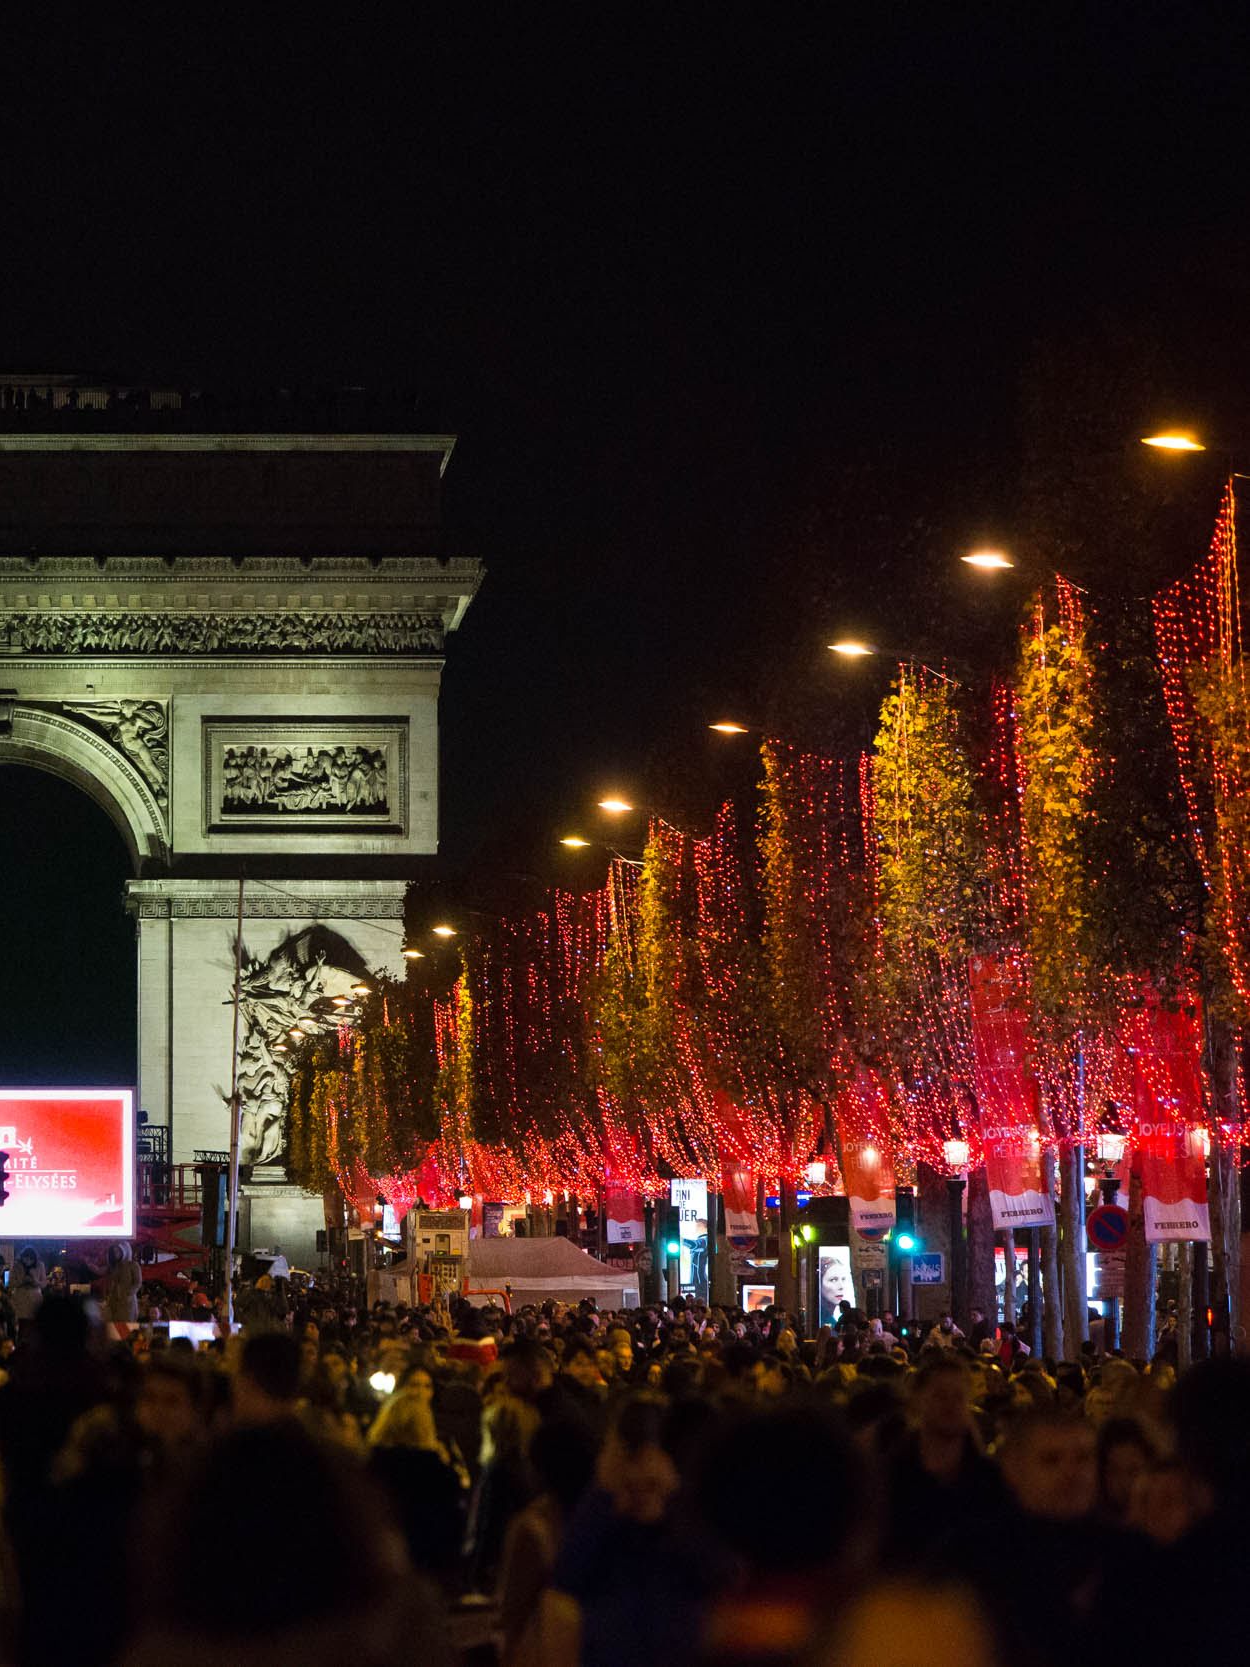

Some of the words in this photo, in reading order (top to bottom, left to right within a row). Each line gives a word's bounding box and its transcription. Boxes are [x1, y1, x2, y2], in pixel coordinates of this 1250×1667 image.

[982, 1124, 1033, 1140] JOYEUSE
[1138, 1122, 1187, 1137] JOYEUS
[1001, 1208, 1043, 1218] FERRERO
[1153, 1221, 1199, 1230] FERRERO
